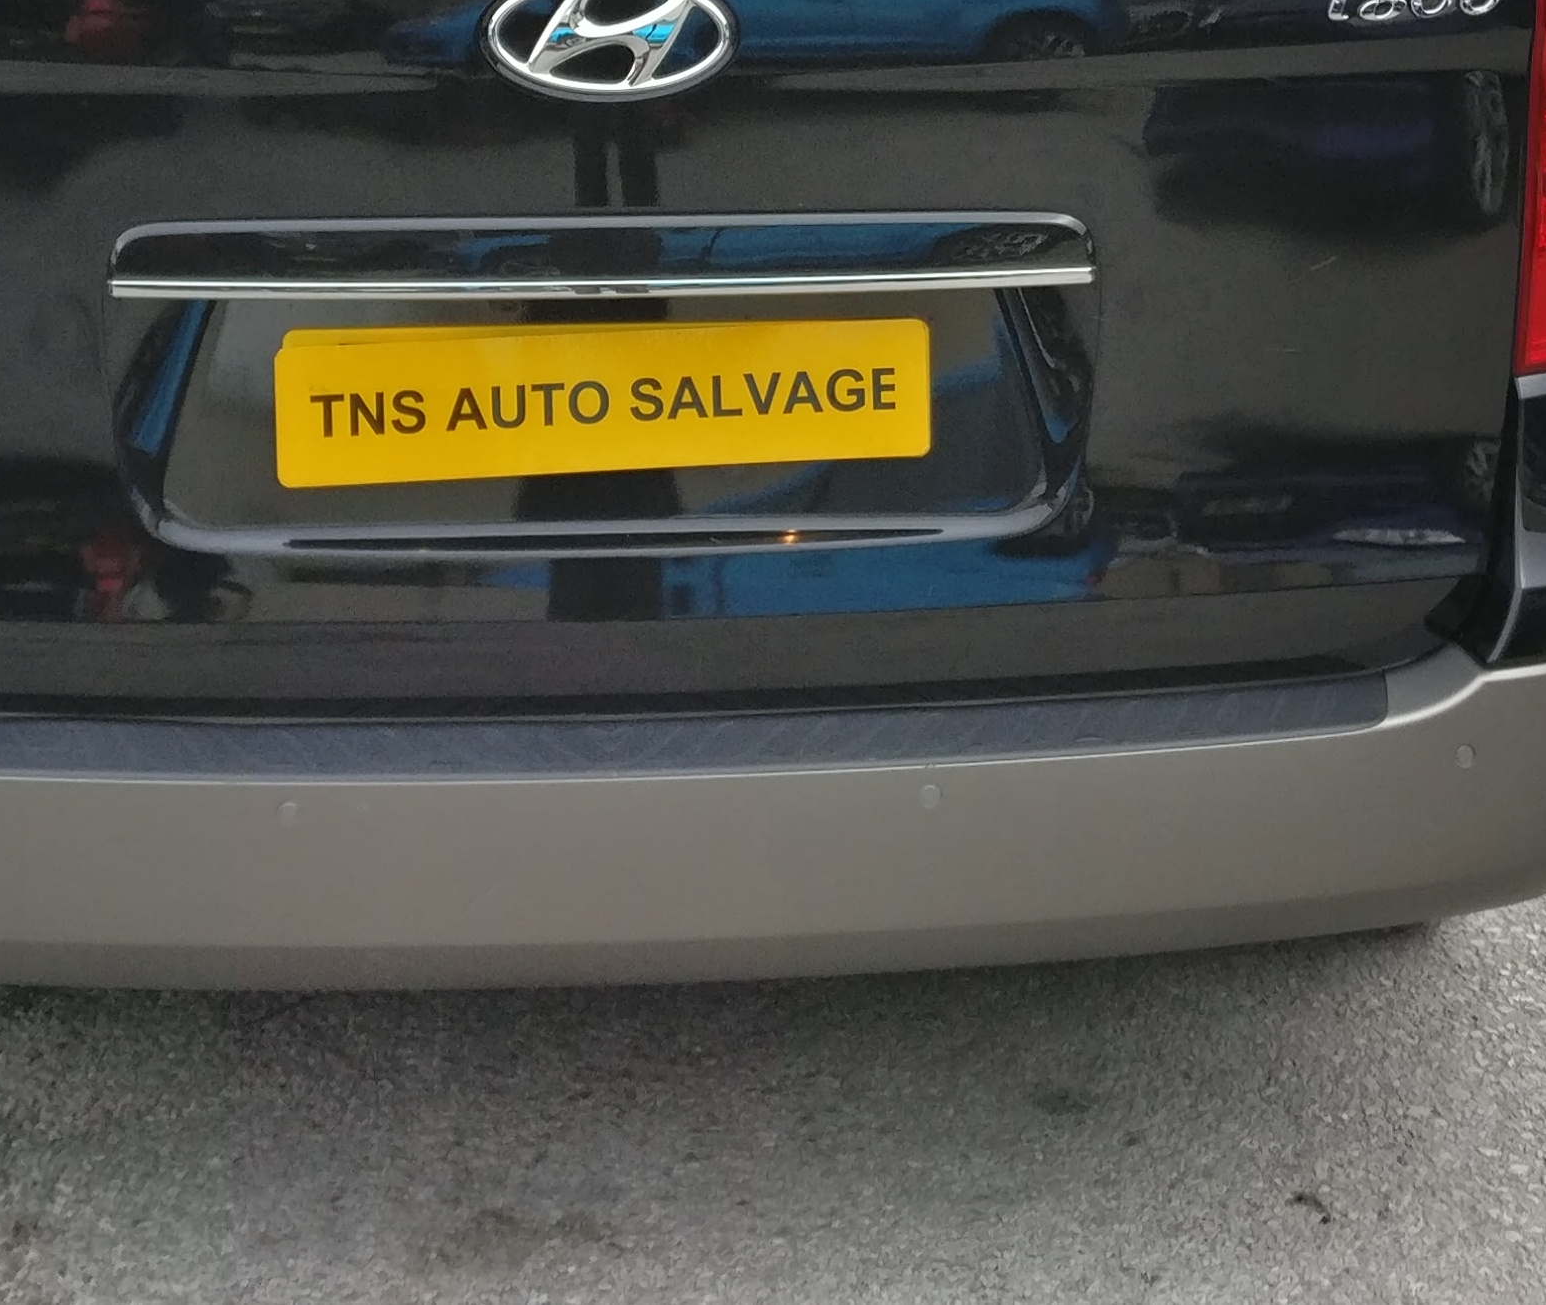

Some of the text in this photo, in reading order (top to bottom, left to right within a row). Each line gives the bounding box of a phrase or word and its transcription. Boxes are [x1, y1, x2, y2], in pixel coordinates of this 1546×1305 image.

[310, 366, 897, 439] TNS AUTO SALVAGE
